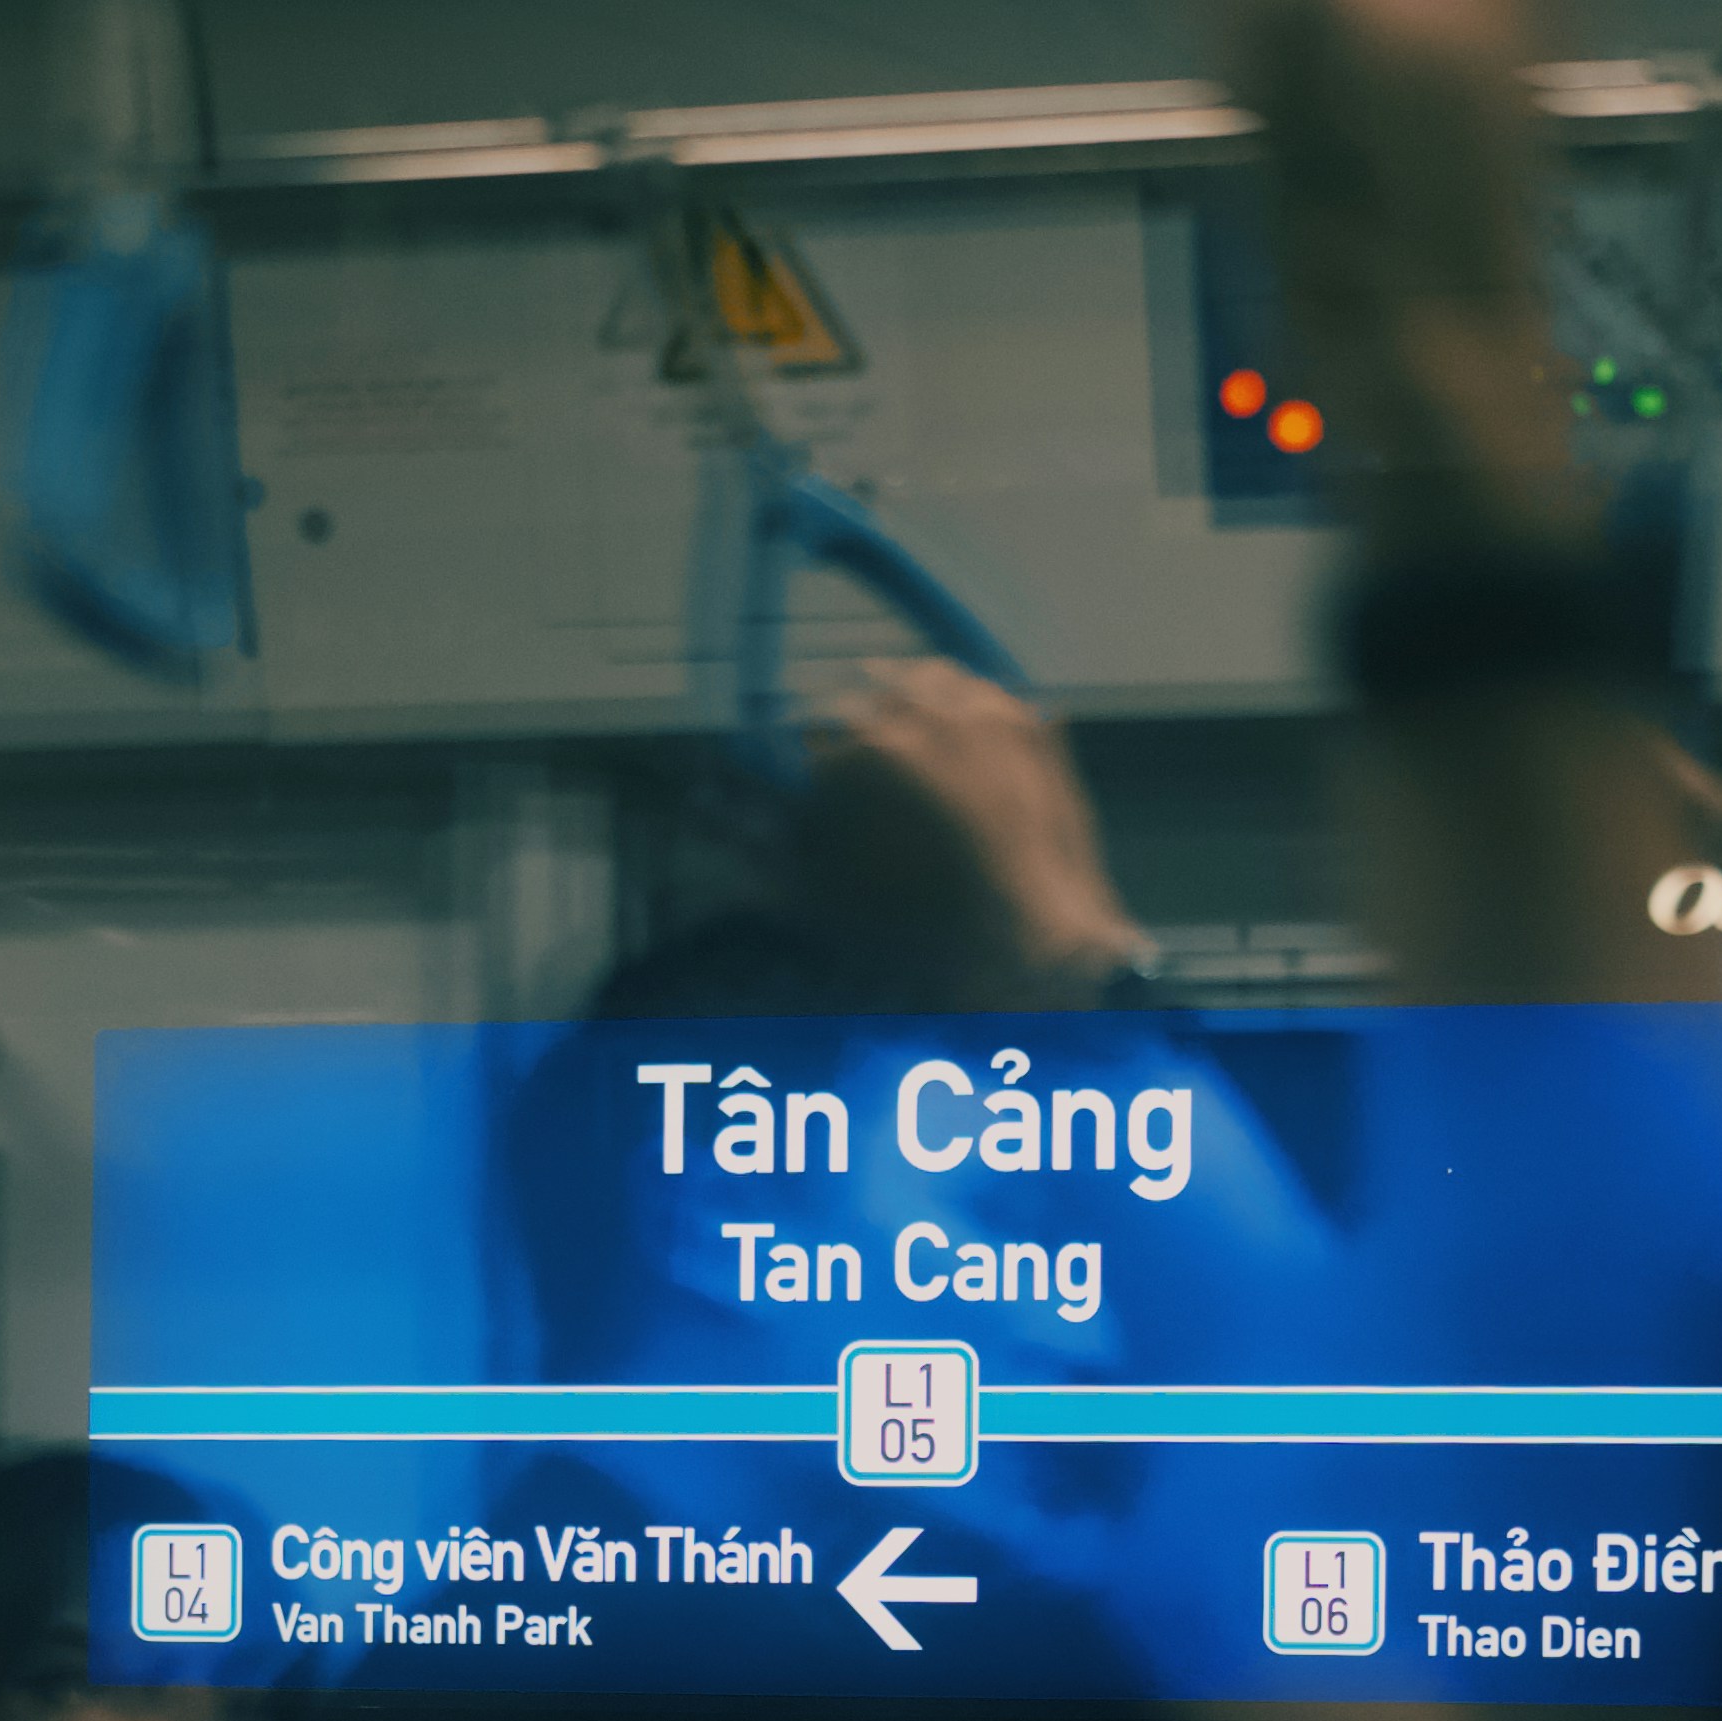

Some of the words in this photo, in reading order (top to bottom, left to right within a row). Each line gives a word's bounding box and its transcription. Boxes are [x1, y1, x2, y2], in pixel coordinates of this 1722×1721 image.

[636, 1063, 850, 1176] Tân
[895, 1047, 1194, 1202] Cảng
[720, 1222, 863, 1304] Tan
[893, 1220, 1103, 1324] Cang
[884, 1362, 933, 1409] L1
[879, 1417, 936, 1465] 05
[167, 1540, 206, 1581] L1
[270, 1523, 405, 1594] Công
[414, 1525, 526, 1583] viên
[534, 1524, 638, 1584] Văn
[644, 1525, 814, 1585] Thánh
[1304, 1549, 1347, 1590] L1
[1417, 1526, 1574, 1593] Thảo
[163, 1585, 210, 1625] 04
[271, 1601, 345, 1644] Van
[354, 1602, 483, 1646] Thanh
[495, 1604, 594, 1647] Park
[1300, 1596, 1349, 1637] 06
[1416, 1613, 1527, 1659] Thao
[1541, 1614, 1641, 1660] Dien
